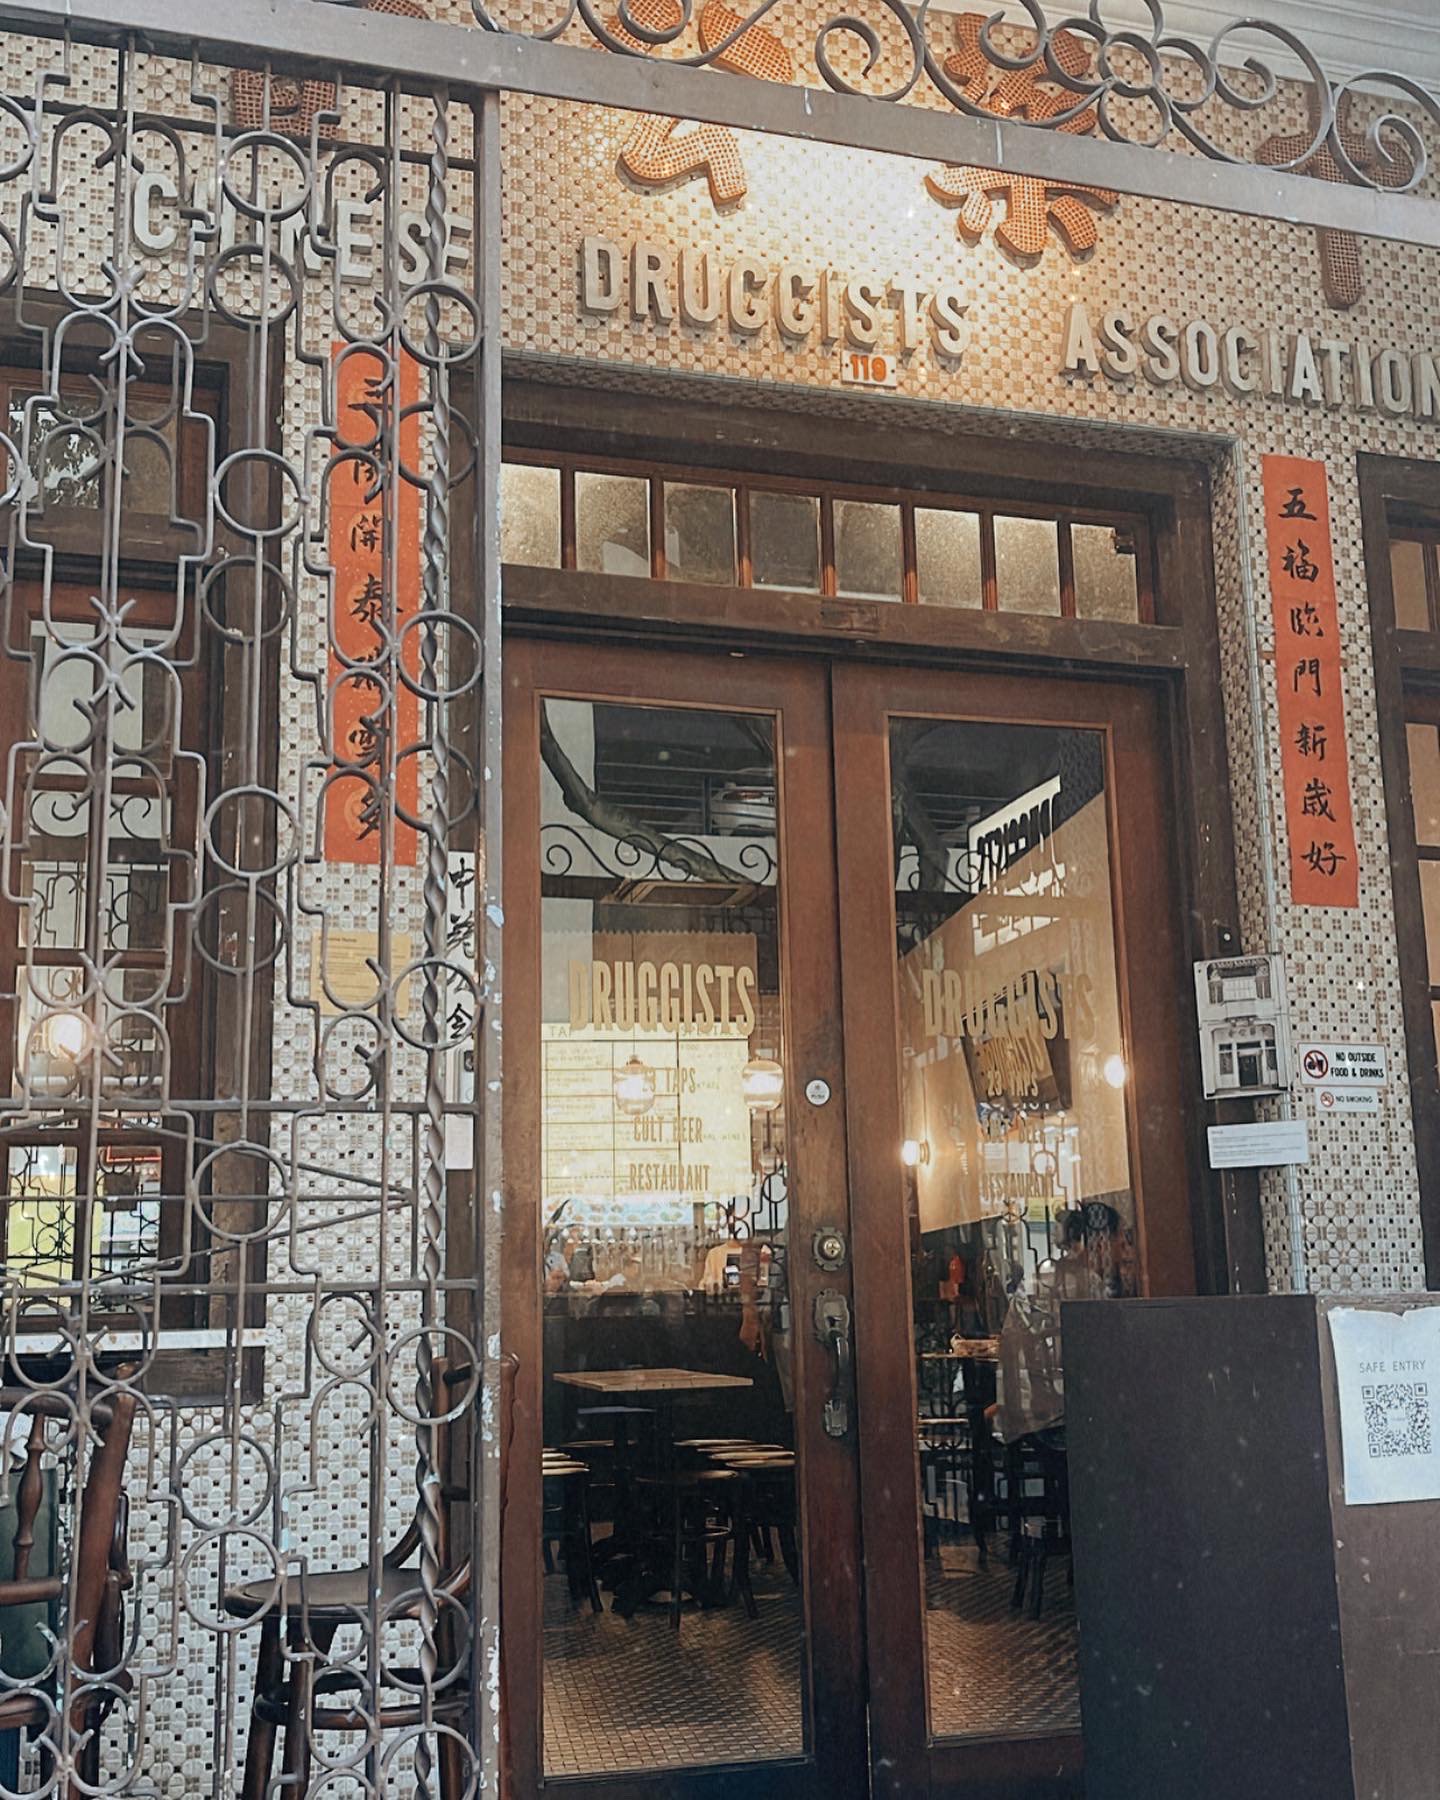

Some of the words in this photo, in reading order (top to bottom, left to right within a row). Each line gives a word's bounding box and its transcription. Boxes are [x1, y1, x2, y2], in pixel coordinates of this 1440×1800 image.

[134, 173, 472, 288] CHINESE
[582, 236, 970, 358] DRUGGISTS
[850, 353, 887, 382] 119
[568, 958, 756, 1036] DRUGGISTS
[1335, 1051, 1346, 1062] NO
[1347, 1051, 1377, 1063] OUTSIDE
[663, 1067, 696, 1094] TAPS
[1330, 1067, 1349, 1078] FOOD
[1351, 1067, 1357, 1077] &
[1359, 1067, 1385, 1078] DRINKS
[1335, 1095, 1345, 1103] NO
[634, 1115, 665, 1143] CULT
[672, 1116, 703, 1144] BEER
[629, 1163, 710, 1191] RESTAURANT
[1359, 1361, 1385, 1374] SAFE
[1392, 1359, 1426, 1372] ENTRY
